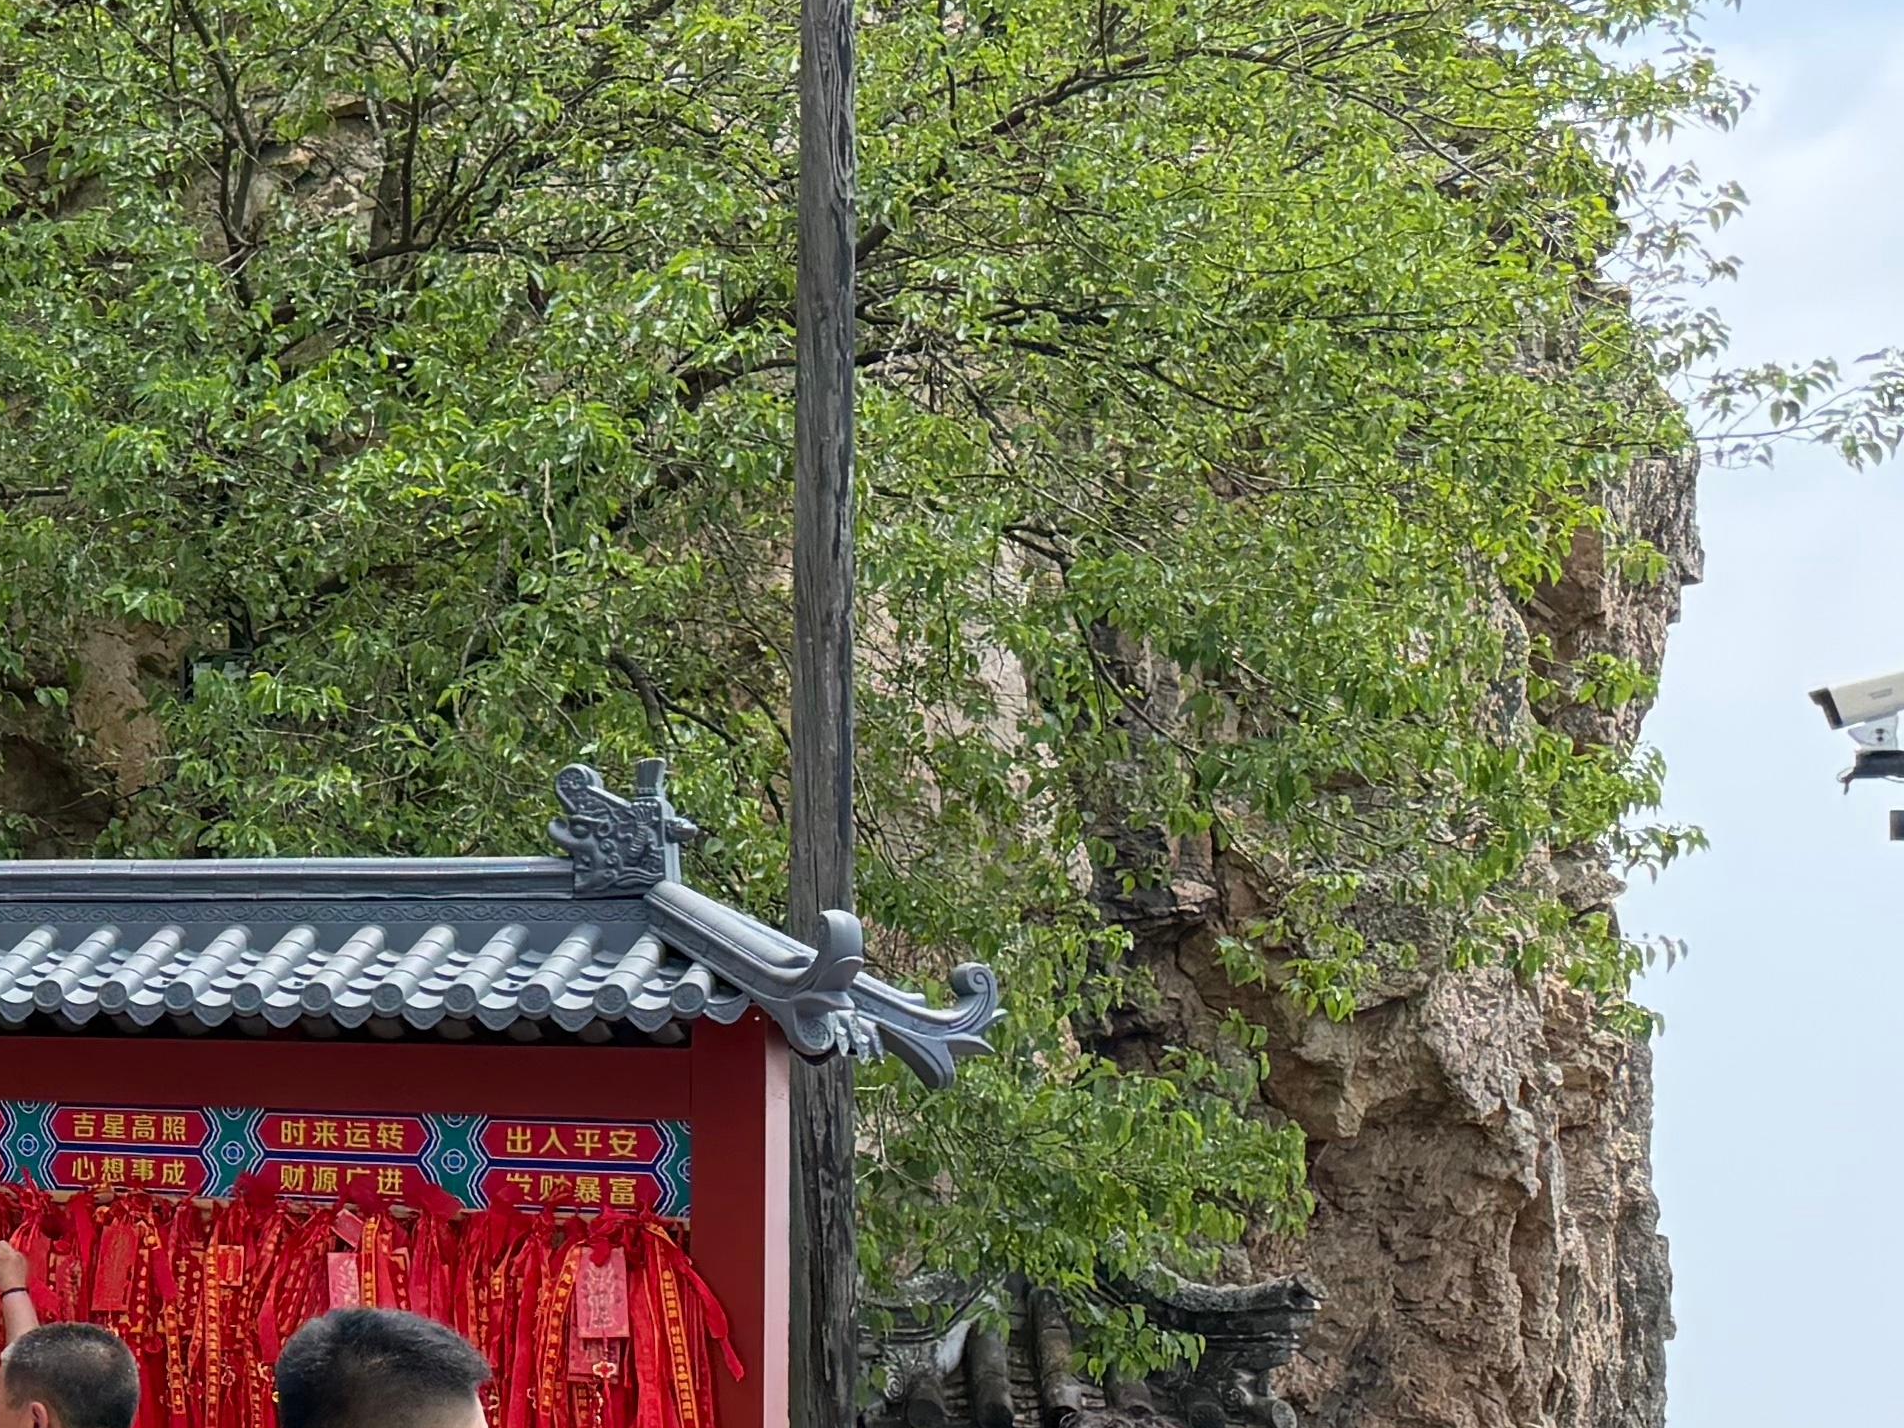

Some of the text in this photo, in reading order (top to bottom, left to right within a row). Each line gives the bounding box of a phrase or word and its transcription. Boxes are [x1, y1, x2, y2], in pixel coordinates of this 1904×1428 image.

[73, 1112, 187, 1142] 吉星高照
[281, 1120, 405, 1151] 时来运转
[506, 1125, 638, 1158] 出入平安
[73, 1155, 186, 1187] 心想事成
